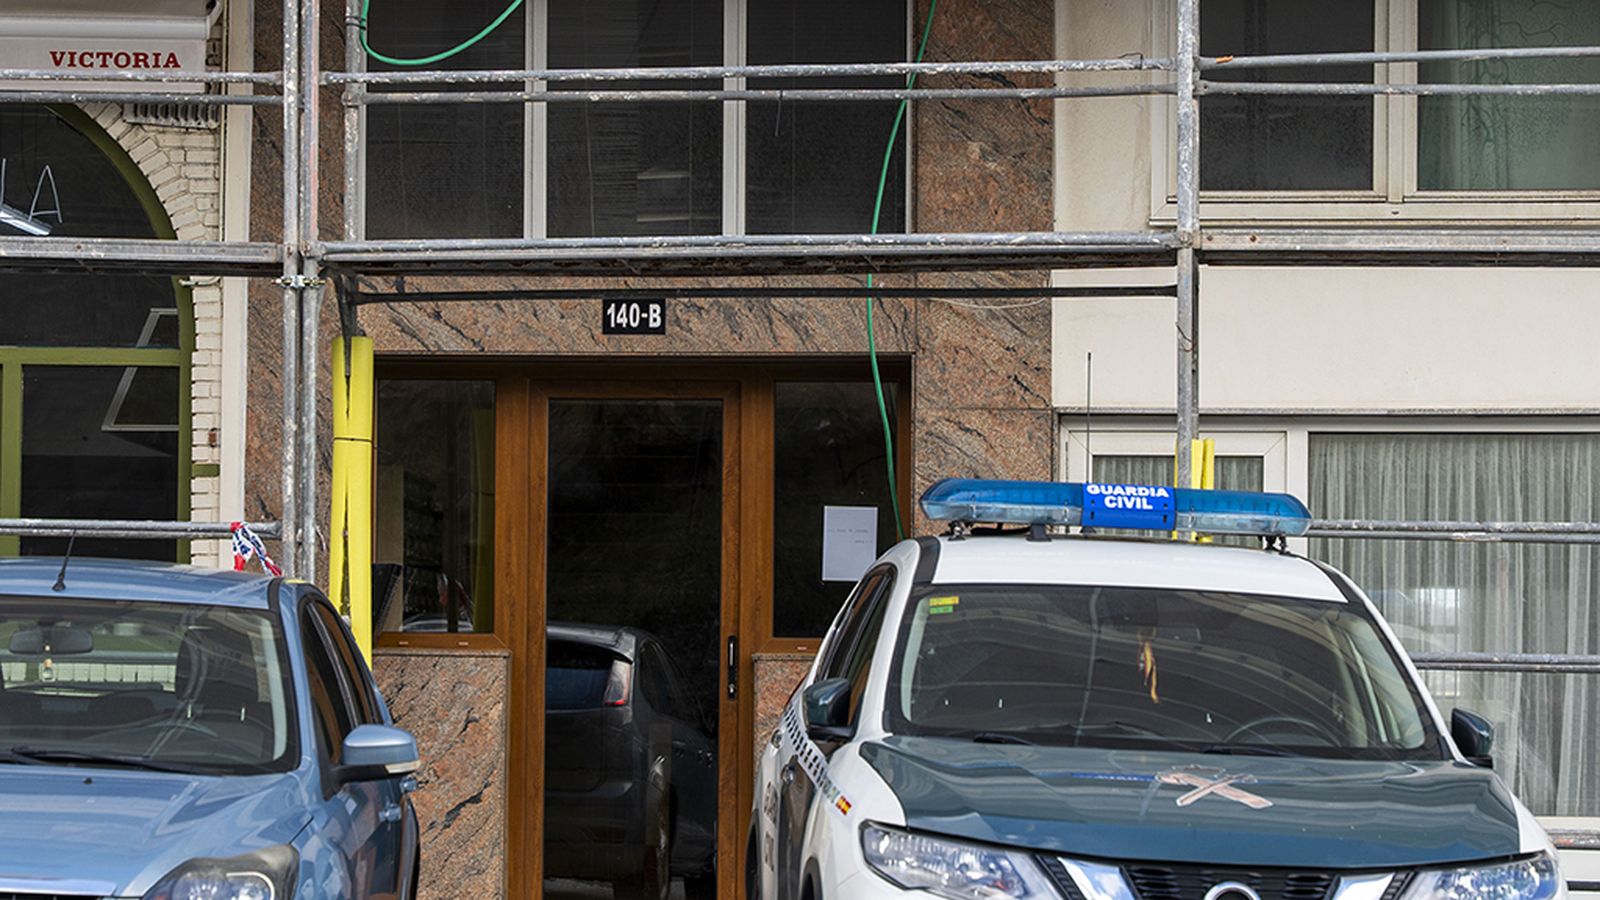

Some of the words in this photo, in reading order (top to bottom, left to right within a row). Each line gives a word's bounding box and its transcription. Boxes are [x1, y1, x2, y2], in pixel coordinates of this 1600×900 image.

[50, 51, 181, 69] VICTORIA
[607, 302, 662, 328] 140-B
[1086, 484, 1170, 498] GUARDIA
[1104, 495, 1154, 510] CIVIL
